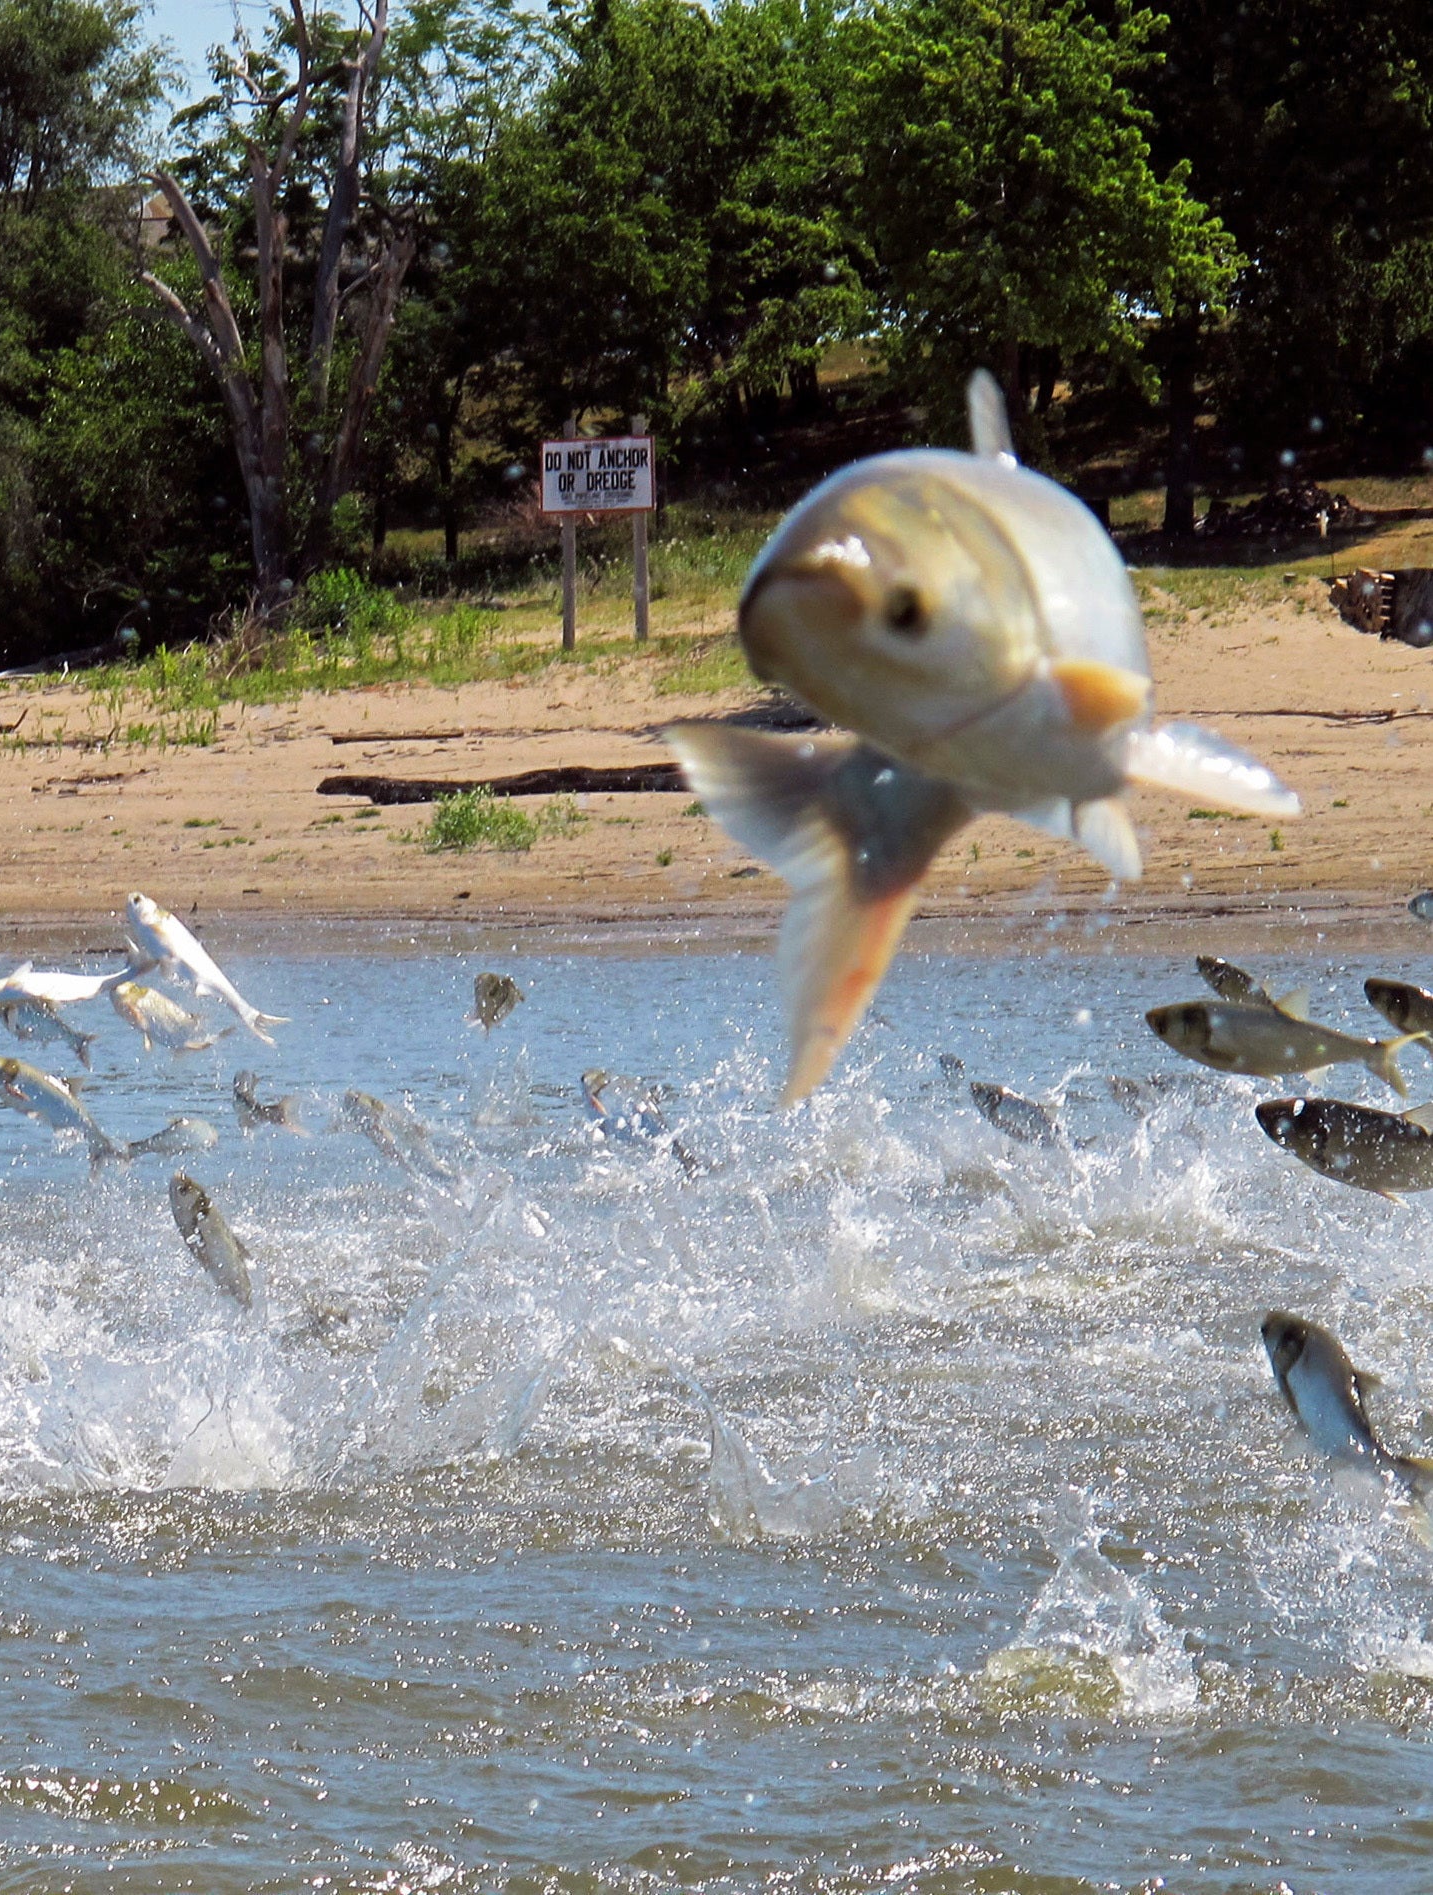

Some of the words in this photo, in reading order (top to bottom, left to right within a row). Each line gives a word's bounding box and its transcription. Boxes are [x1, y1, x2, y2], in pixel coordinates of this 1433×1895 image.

[545, 452, 562, 472] DO
[567, 450, 592, 470] NOT
[598, 448, 648, 469] ANCHOR
[558, 473, 575, 492] OR
[586, 470, 636, 491] DREDGE
